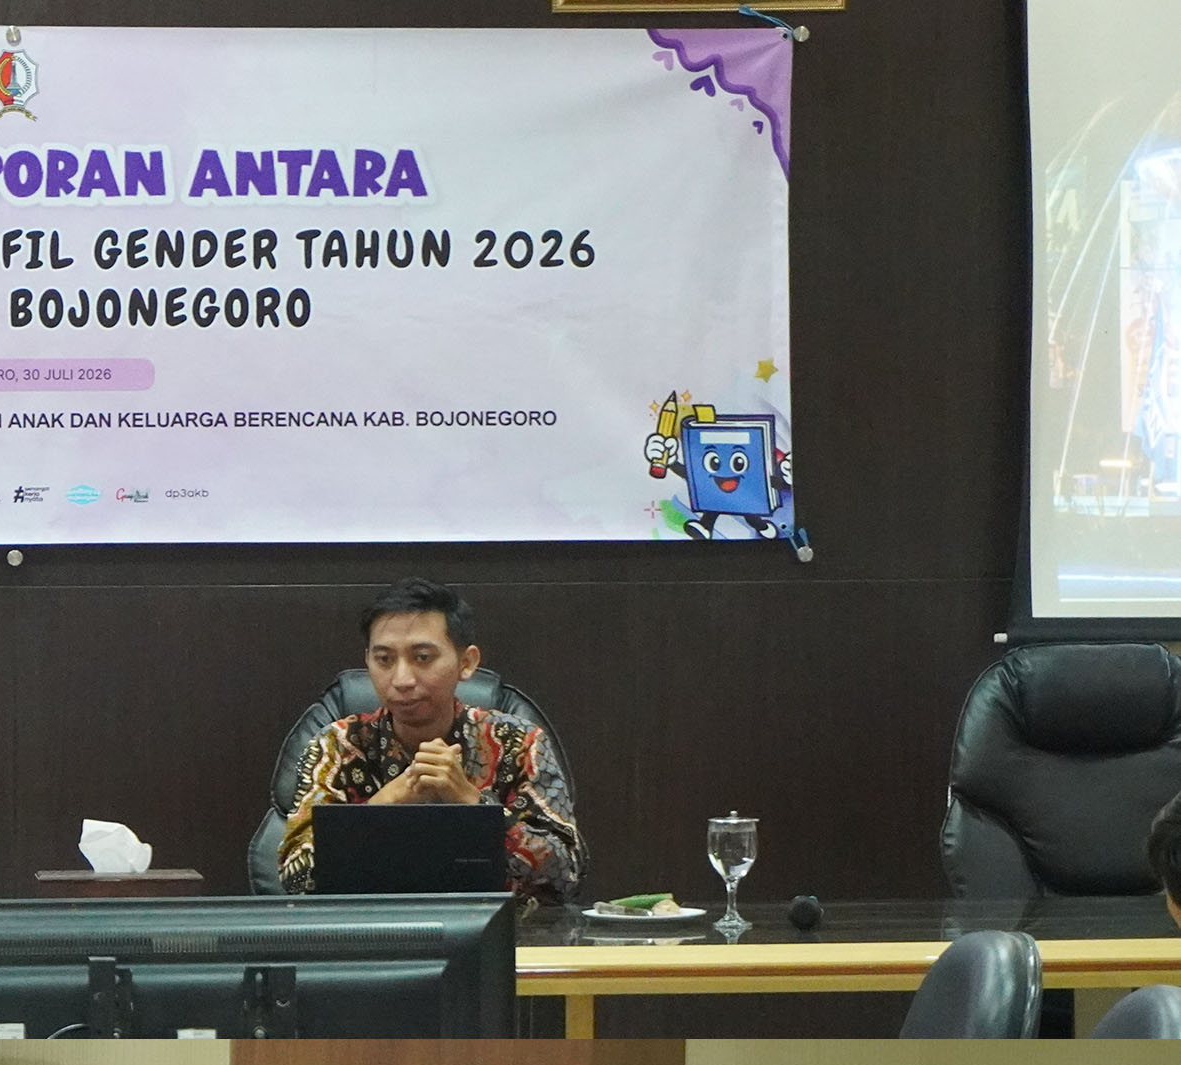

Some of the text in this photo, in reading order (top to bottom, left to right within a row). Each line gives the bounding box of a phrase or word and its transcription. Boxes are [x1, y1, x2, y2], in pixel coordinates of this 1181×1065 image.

[189, 149, 428, 197] ANTARA
[94, 229, 278, 270] GENDER
[295, 229, 451, 269] TAHUN
[473, 229, 595, 269] 2026
[10, 287, 311, 329] BOJONEGORO
[23, 368, 41, 381] 30
[44, 368, 74, 381] JULI
[78, 368, 112, 381] 2026
[8, 412, 65, 429] ANAK
[71, 412, 112, 428] DAN
[118, 411, 229, 428] KELUARGA
[234, 411, 358, 427] BERENCANA
[363, 411, 410, 427] KAB.
[416, 410, 557, 427] BOJONEGORO
[165, 488, 209, 499] dp3akb
